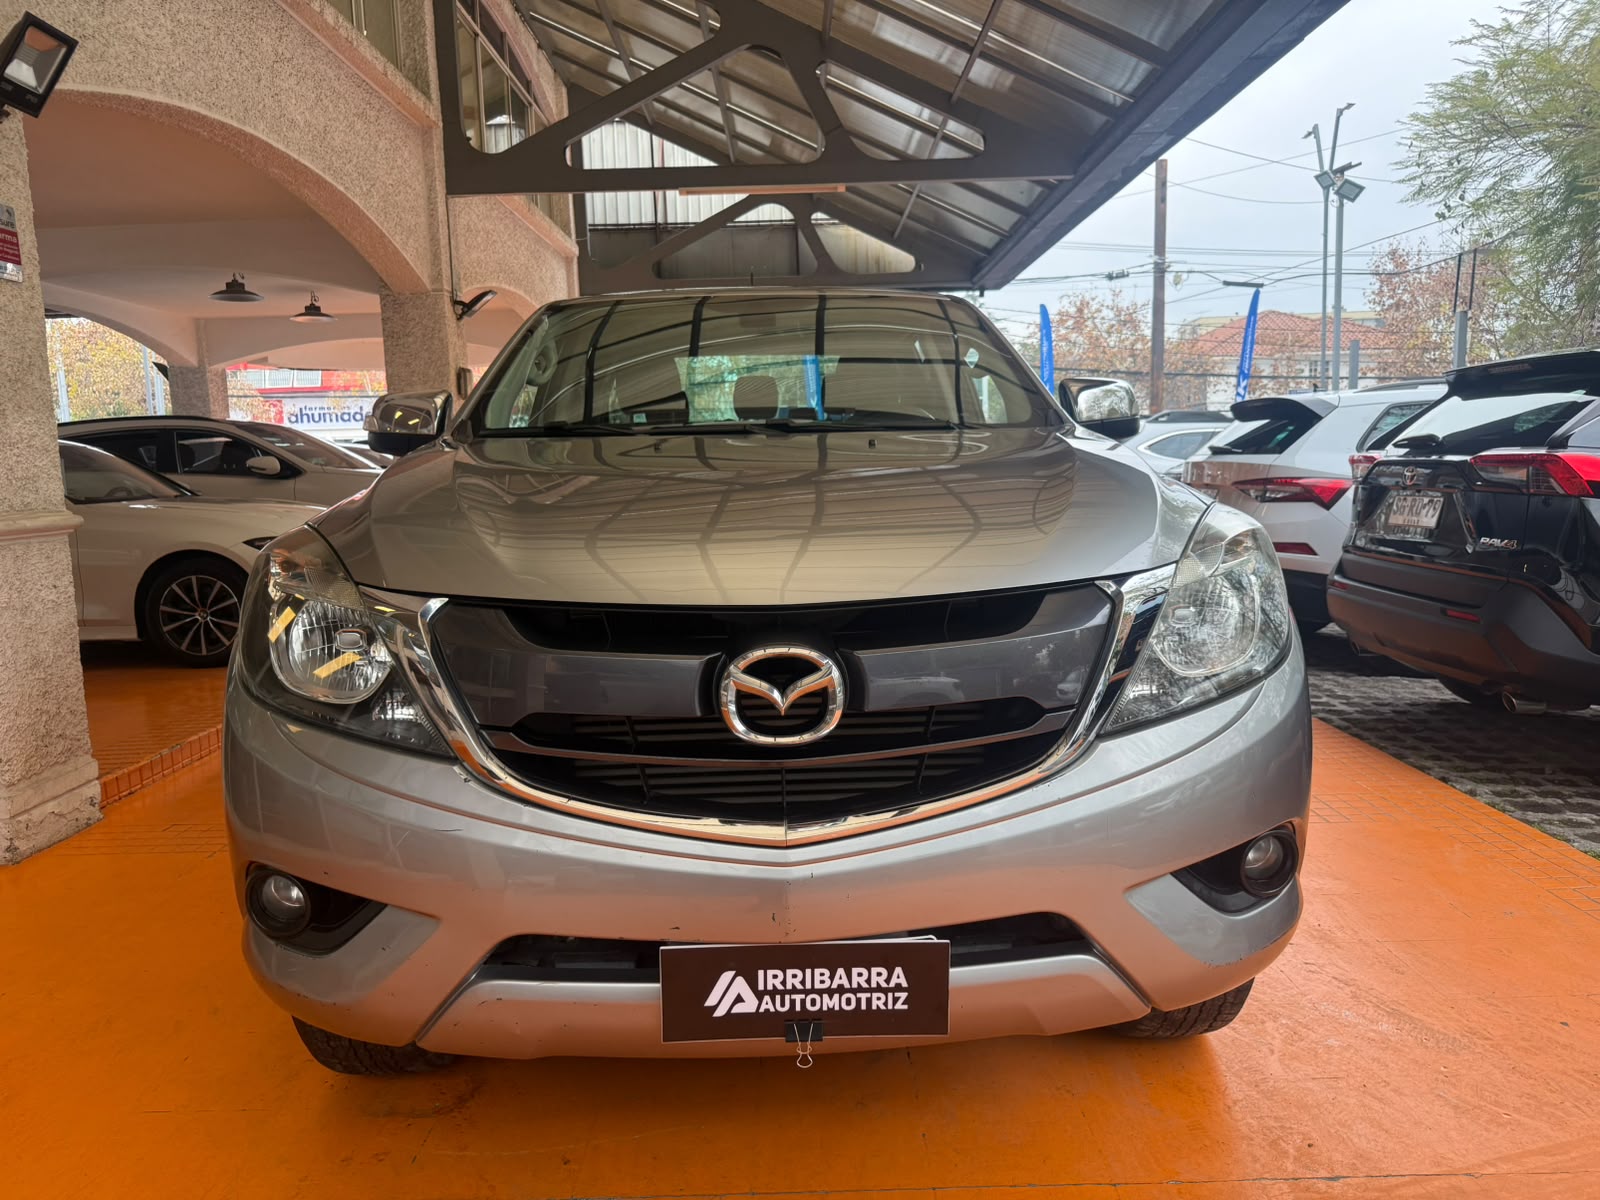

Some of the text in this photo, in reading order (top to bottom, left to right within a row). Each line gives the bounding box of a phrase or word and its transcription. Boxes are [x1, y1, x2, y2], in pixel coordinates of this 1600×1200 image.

[288, 406, 373, 424] ahumad
[1480, 537, 1518, 549] RAV4
[757, 967, 909, 991] IRRIBARRA
[759, 992, 909, 1013] AUTOMOTRIZ
